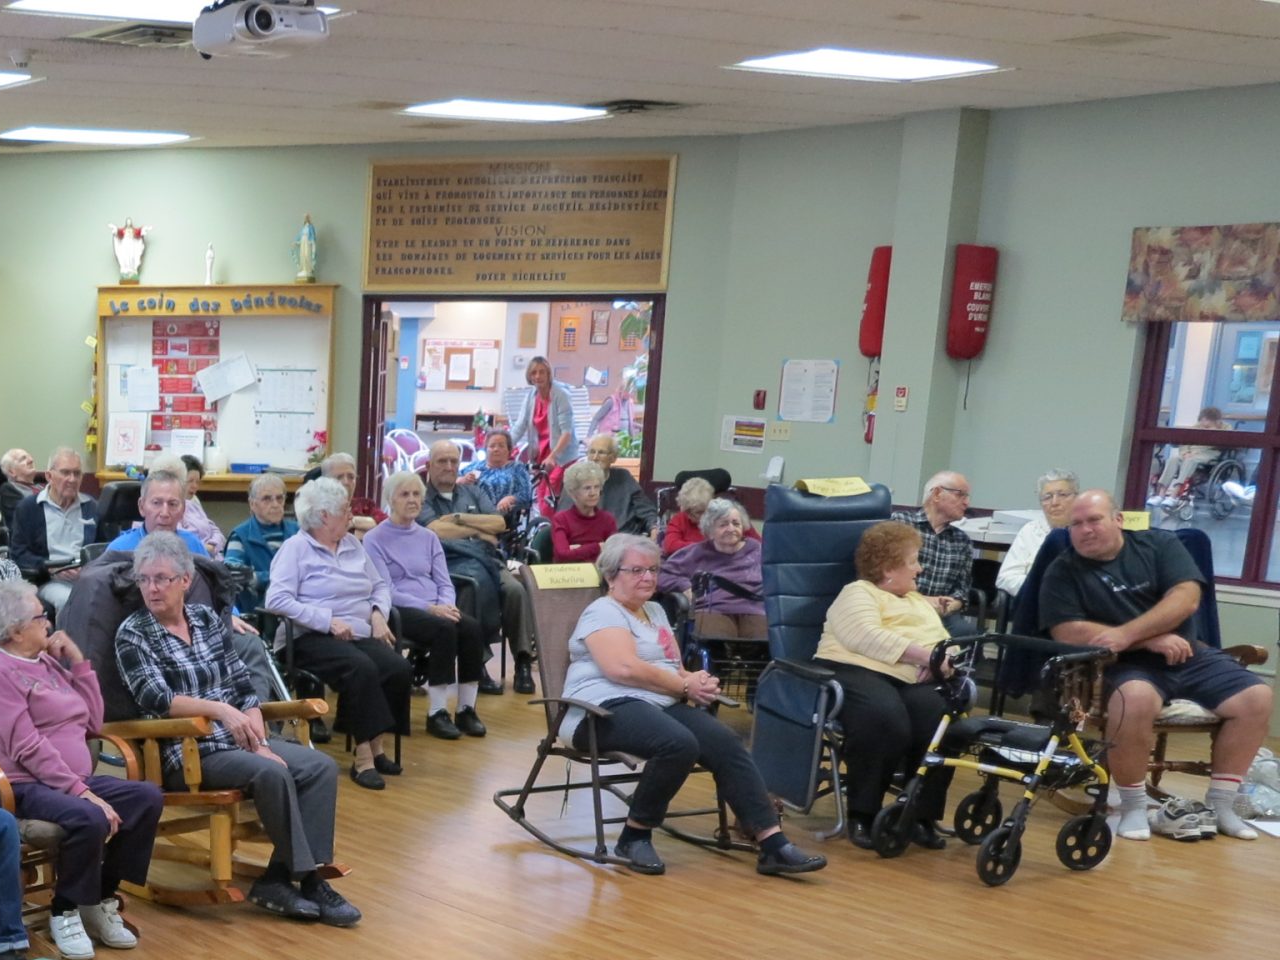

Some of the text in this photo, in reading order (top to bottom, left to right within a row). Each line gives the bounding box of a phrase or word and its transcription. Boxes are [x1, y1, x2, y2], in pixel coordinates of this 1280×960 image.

[494, 224, 547, 237] VISION
[109, 300, 129, 315] Le
[137, 292, 176, 313] coin
[189, 297, 221, 313] des
